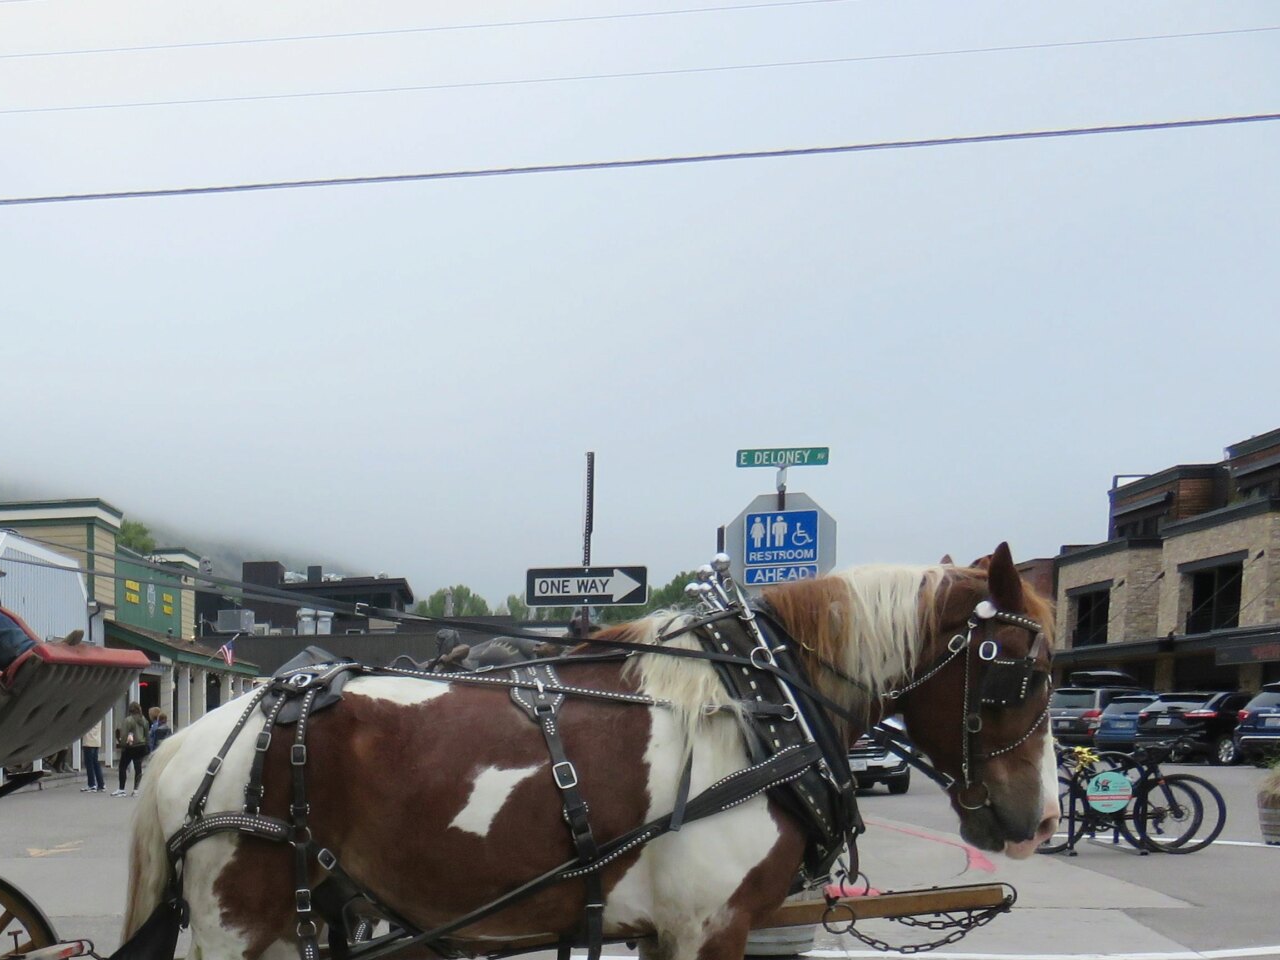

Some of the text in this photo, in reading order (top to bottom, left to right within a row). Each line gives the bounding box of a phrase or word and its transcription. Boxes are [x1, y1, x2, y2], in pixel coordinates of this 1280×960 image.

[741, 452, 748, 465] E
[754, 450, 811, 464] DELONEY
[749, 549, 814, 562] RESTROOM
[753, 567, 809, 583] AHEAD
[538, 578, 610, 594] ONE WAY
